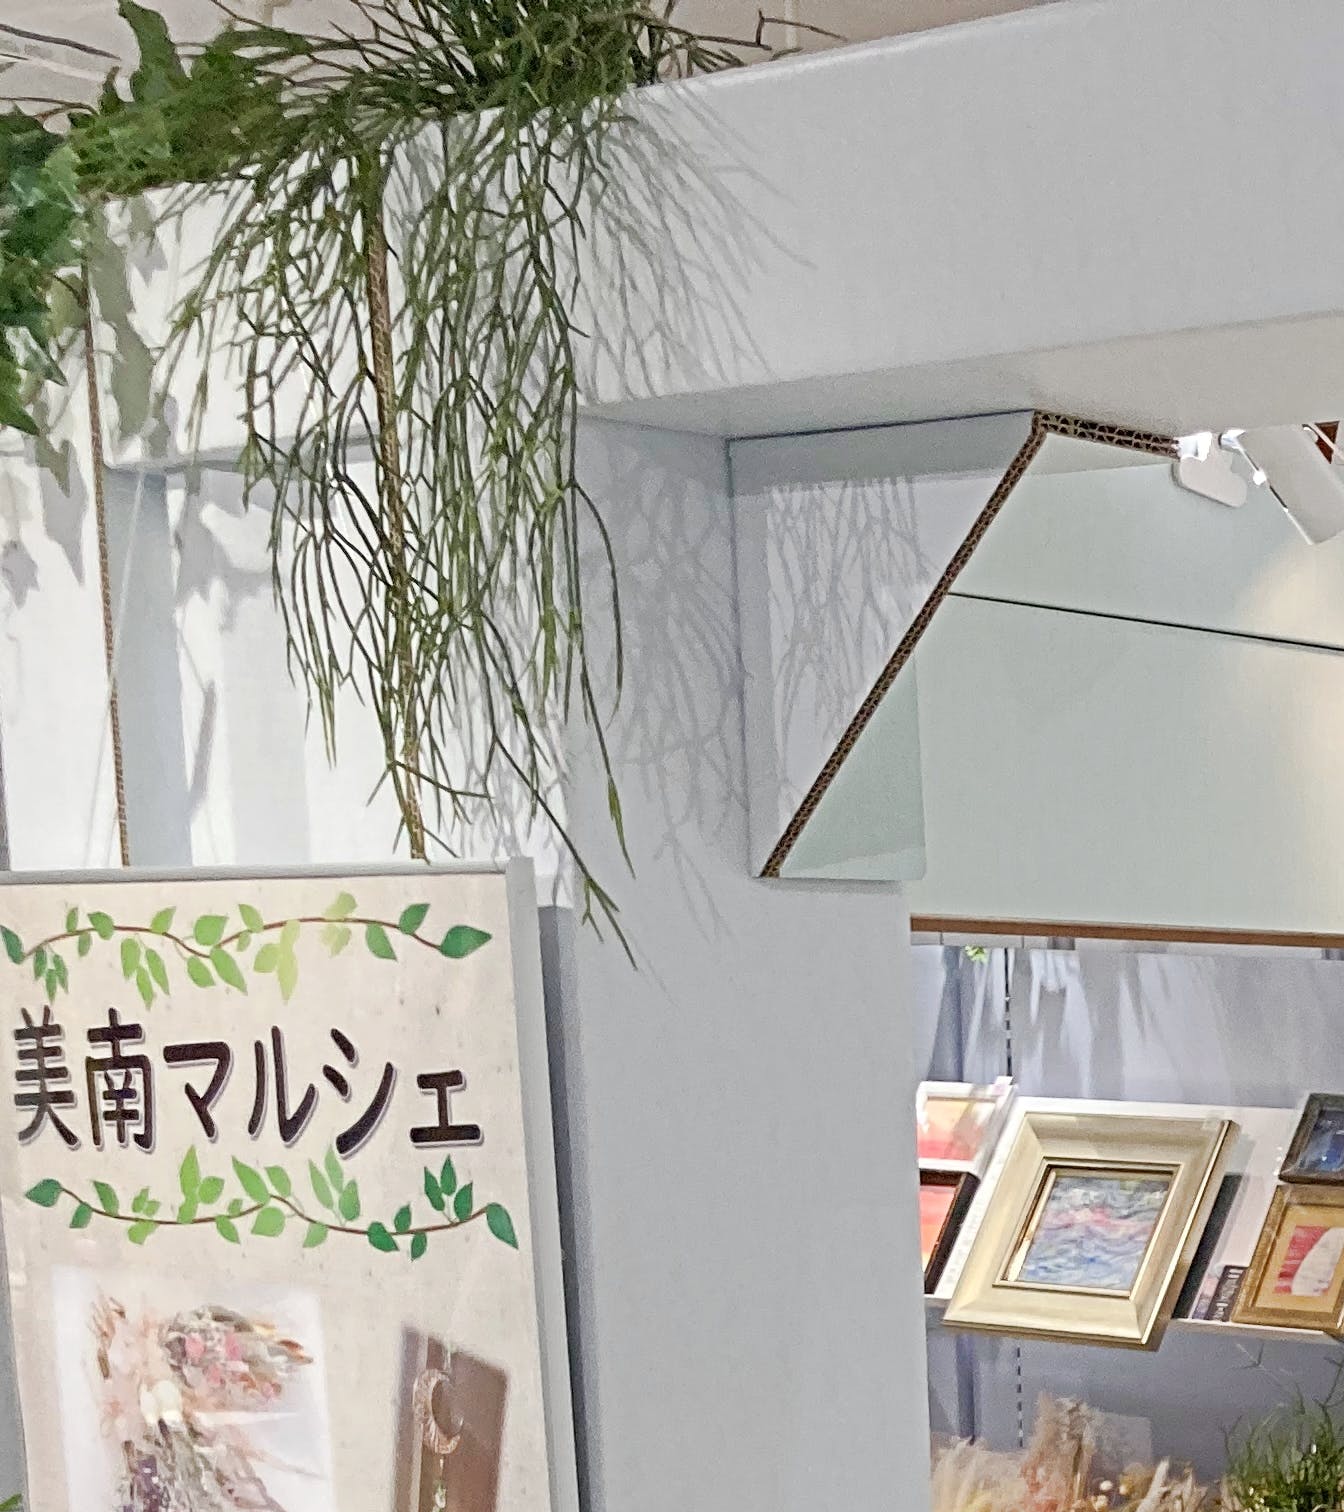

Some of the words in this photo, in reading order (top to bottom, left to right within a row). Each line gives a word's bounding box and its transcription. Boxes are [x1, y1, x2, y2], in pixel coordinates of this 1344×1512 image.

[13, 1005, 484, 1158] 美南マルシェ
